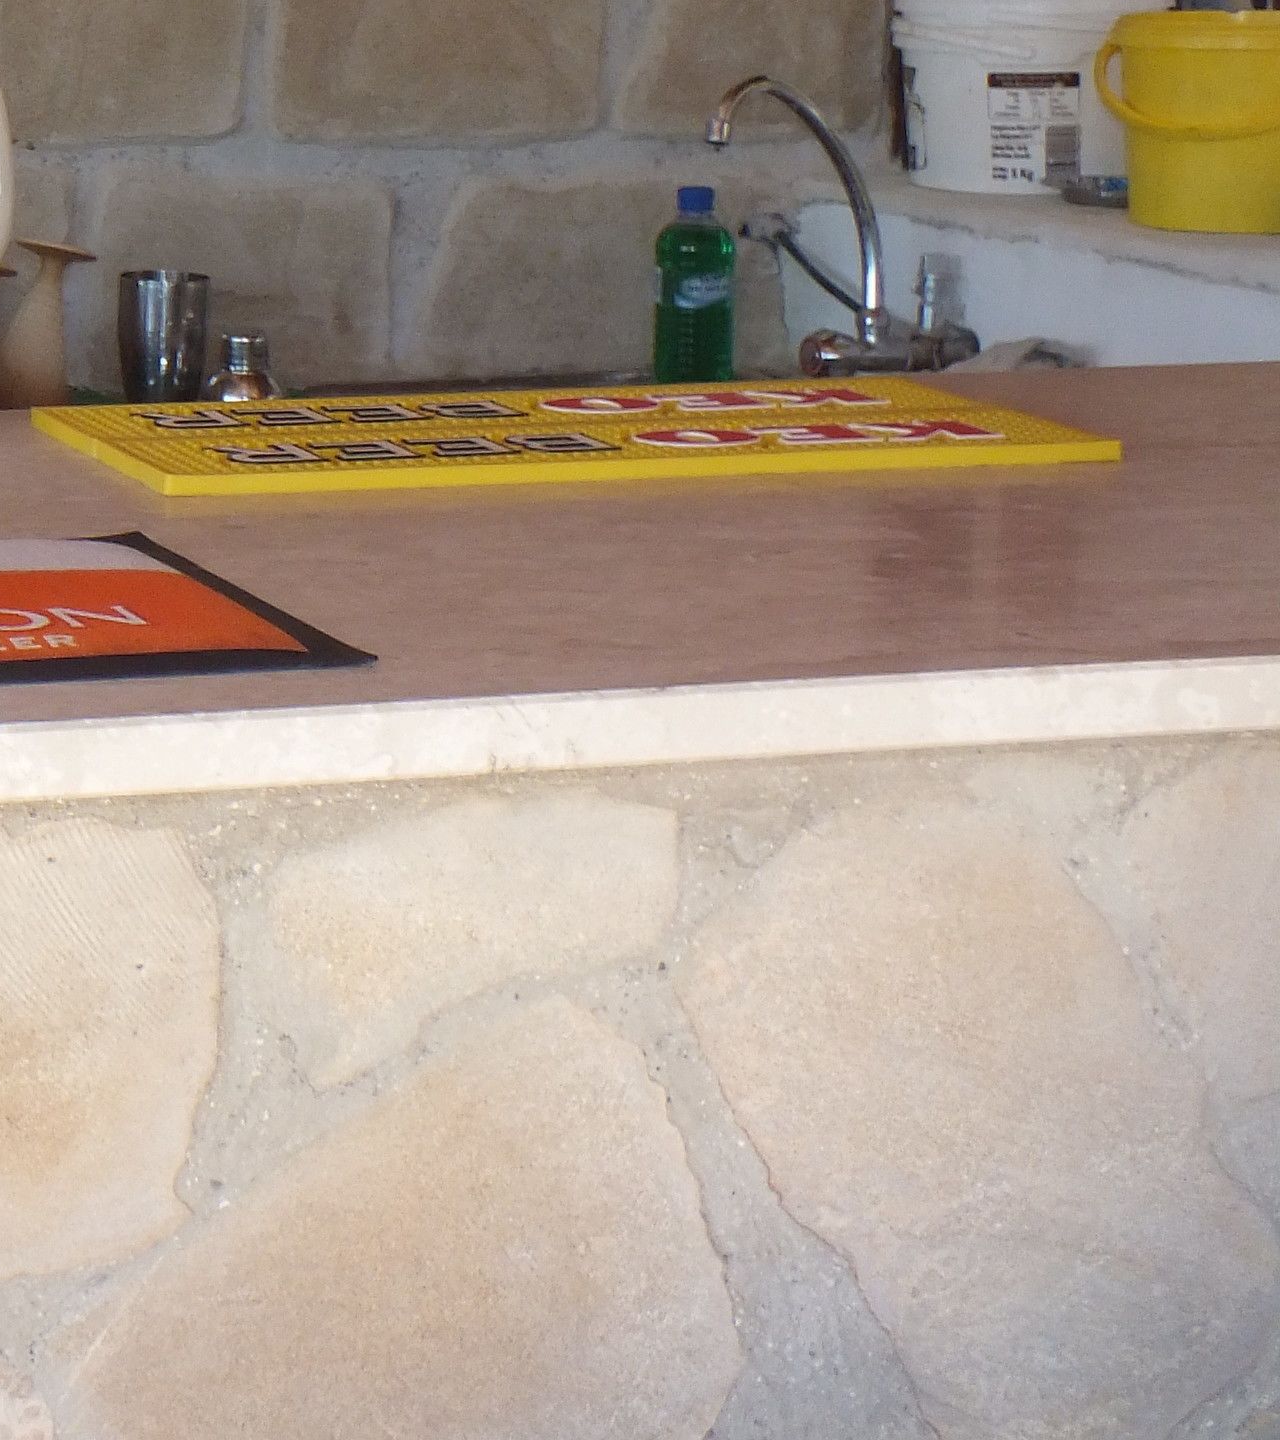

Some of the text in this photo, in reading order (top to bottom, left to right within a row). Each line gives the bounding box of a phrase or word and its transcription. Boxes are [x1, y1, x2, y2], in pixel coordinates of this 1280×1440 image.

[128, 387, 891, 430] KEO BEER
[202, 419, 1005, 464] KEO BEER
